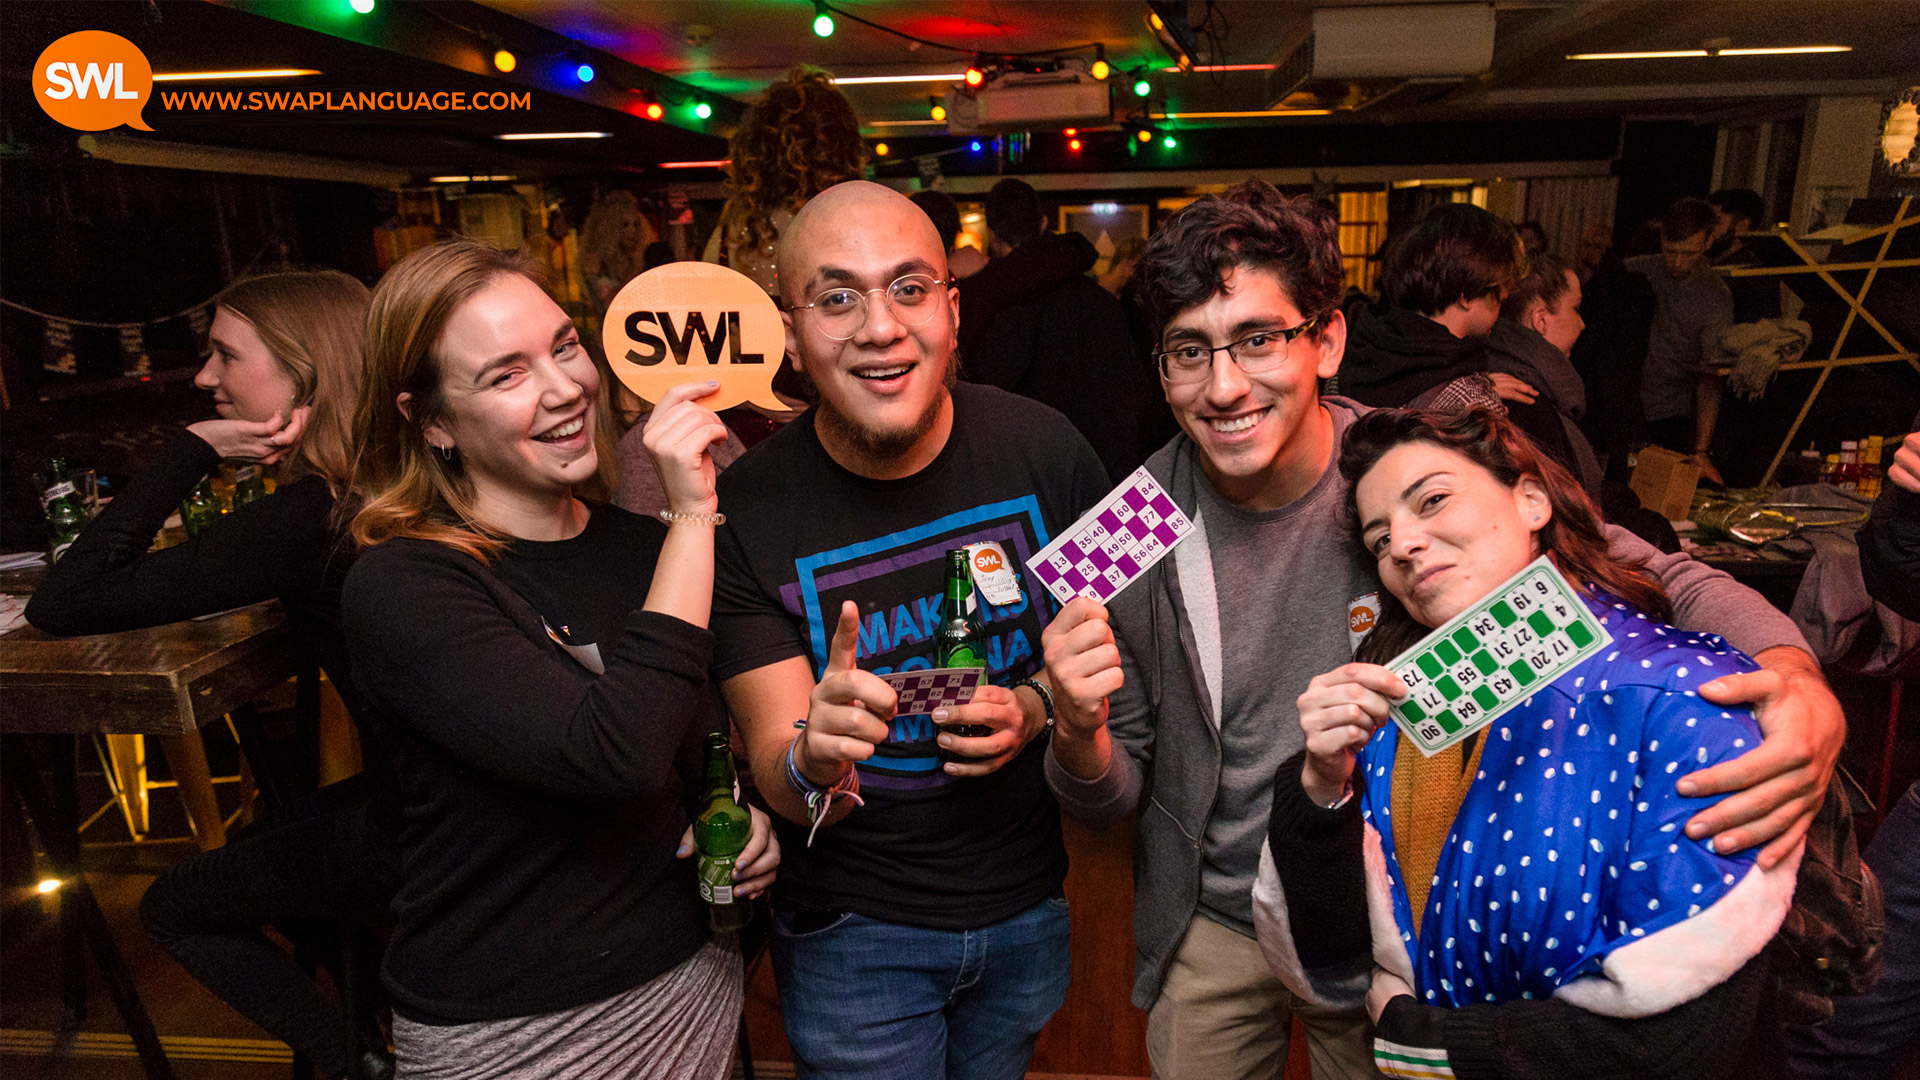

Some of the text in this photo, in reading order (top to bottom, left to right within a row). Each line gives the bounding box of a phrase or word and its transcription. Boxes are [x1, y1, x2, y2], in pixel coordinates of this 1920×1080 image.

[625, 311, 764, 366] SWL
[1054, 483, 1154, 569] 13 35 40 60 84
[1082, 564, 1094, 576] 25
[1107, 544, 1119, 555] 49
[1119, 533, 1131, 545] 50
[1143, 511, 1155, 523] 77
[1109, 570, 1120, 582] 37
[1134, 550, 1146, 562] 56
[1146, 539, 1159, 551] 64
[1171, 518, 1183, 530] 85
[977, 555, 1000, 568] SWL
[1351, 612, 1372, 628] SWL
[1403, 582, 1548, 686] 6 19 34 73
[1423, 605, 1567, 708] 4 27 31 55 71
[1421, 640, 1569, 740] 17 20 43 64 90
